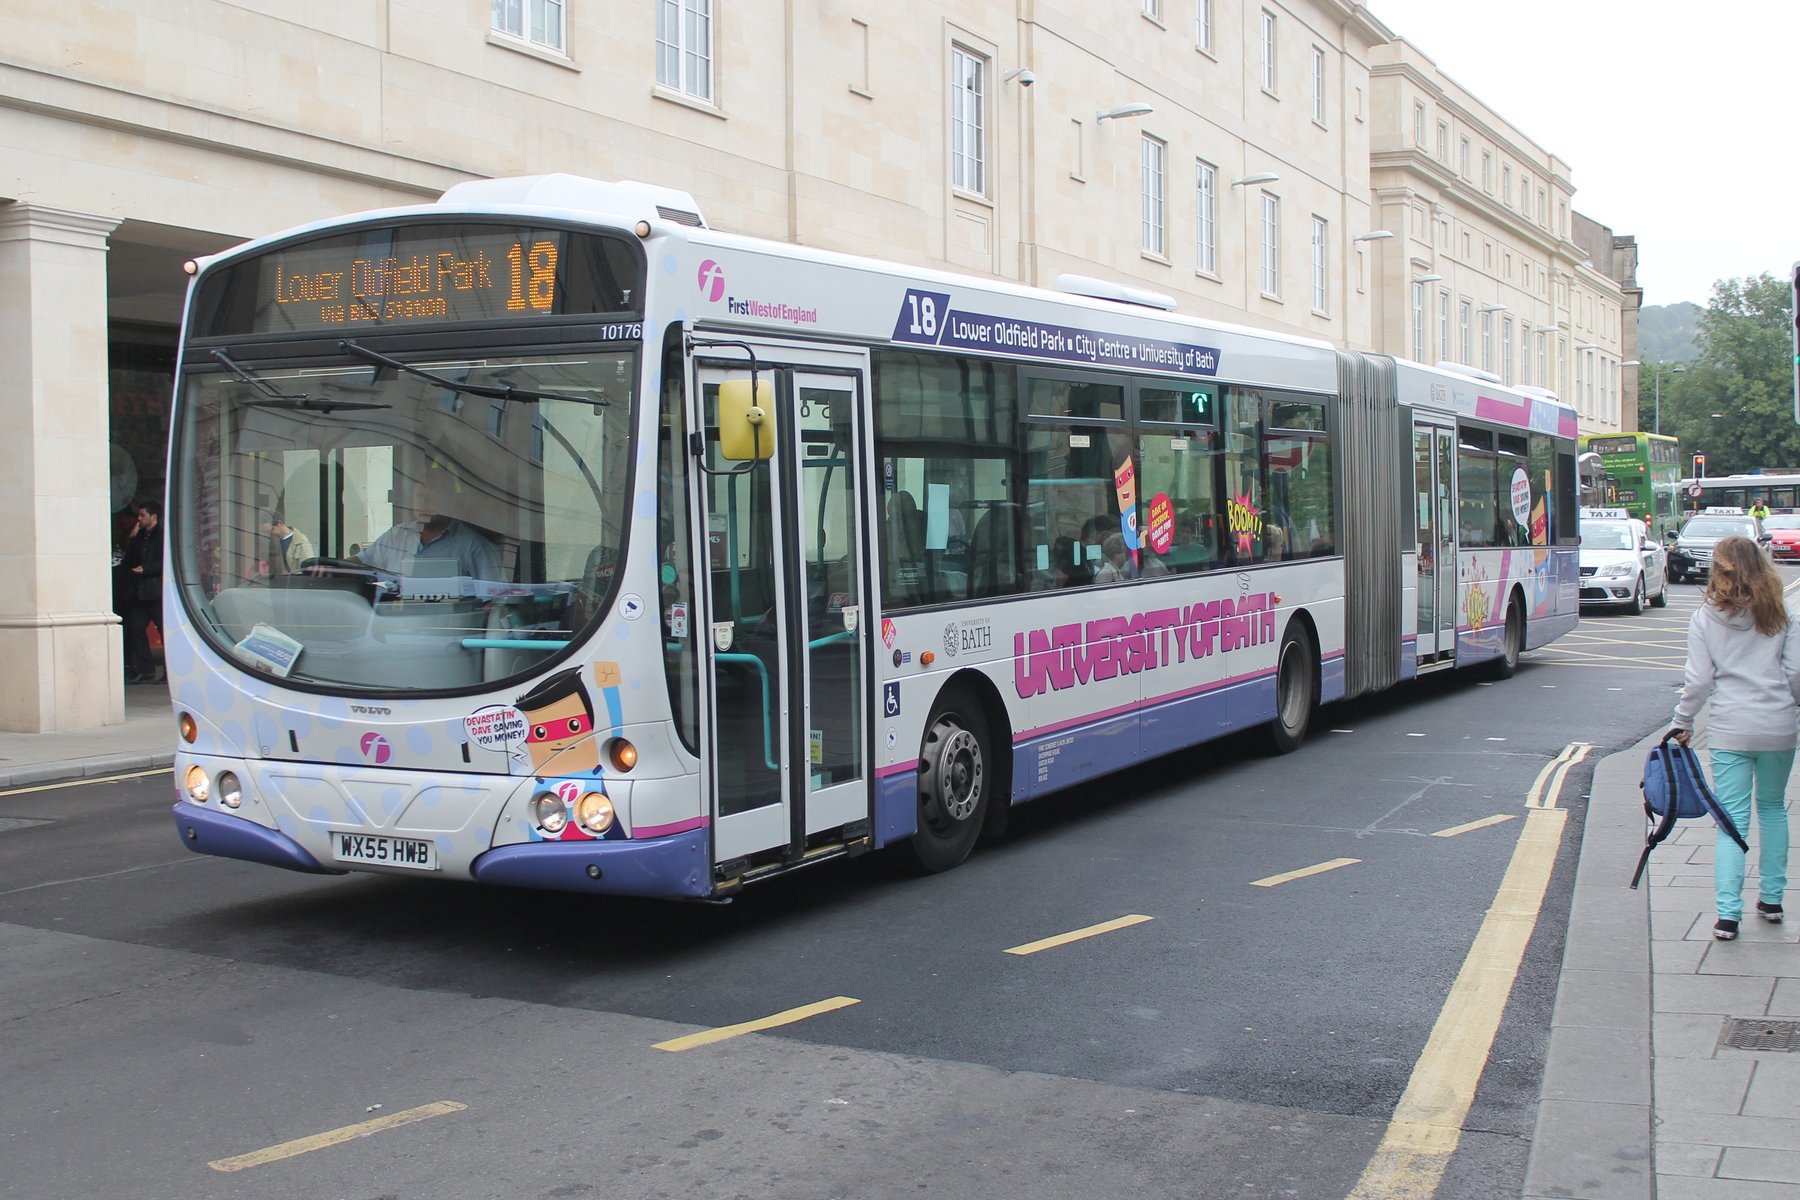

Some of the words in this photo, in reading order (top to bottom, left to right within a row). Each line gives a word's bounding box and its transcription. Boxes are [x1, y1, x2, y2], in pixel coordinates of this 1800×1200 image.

[278, 267, 344, 304] Lower
[352, 255, 430, 297] Oldfield
[437, 250, 494, 292] Park
[506, 240, 558, 312] 18
[908, 295, 937, 336] 18
[601, 324, 641, 340] 10176
[953, 317, 991, 342] Lower
[994, 322, 1038, 349] Oldfield
[1041, 330, 1065, 351] Park
[1076, 334, 1097, 361] City
[1098, 338, 1130, 359] Centre
[1139, 343, 1184, 371] University
[1185, 349, 1195, 367] of
[1196, 350, 1215, 369] Bath
[1227, 499, 1262, 541] BOOM!!
[961, 626, 992, 650] BATH
[350, 705, 392, 715] VOLVO
[466, 709, 517, 726] DEVASTATIN'
[472, 725, 491, 735] DAVE
[494, 720, 523, 732] SAVING
[477, 736, 493, 744] YOU
[495, 729, 525, 742] MONEY!
[341, 835, 388, 860] WX55
[393, 840, 429, 864] HWB
